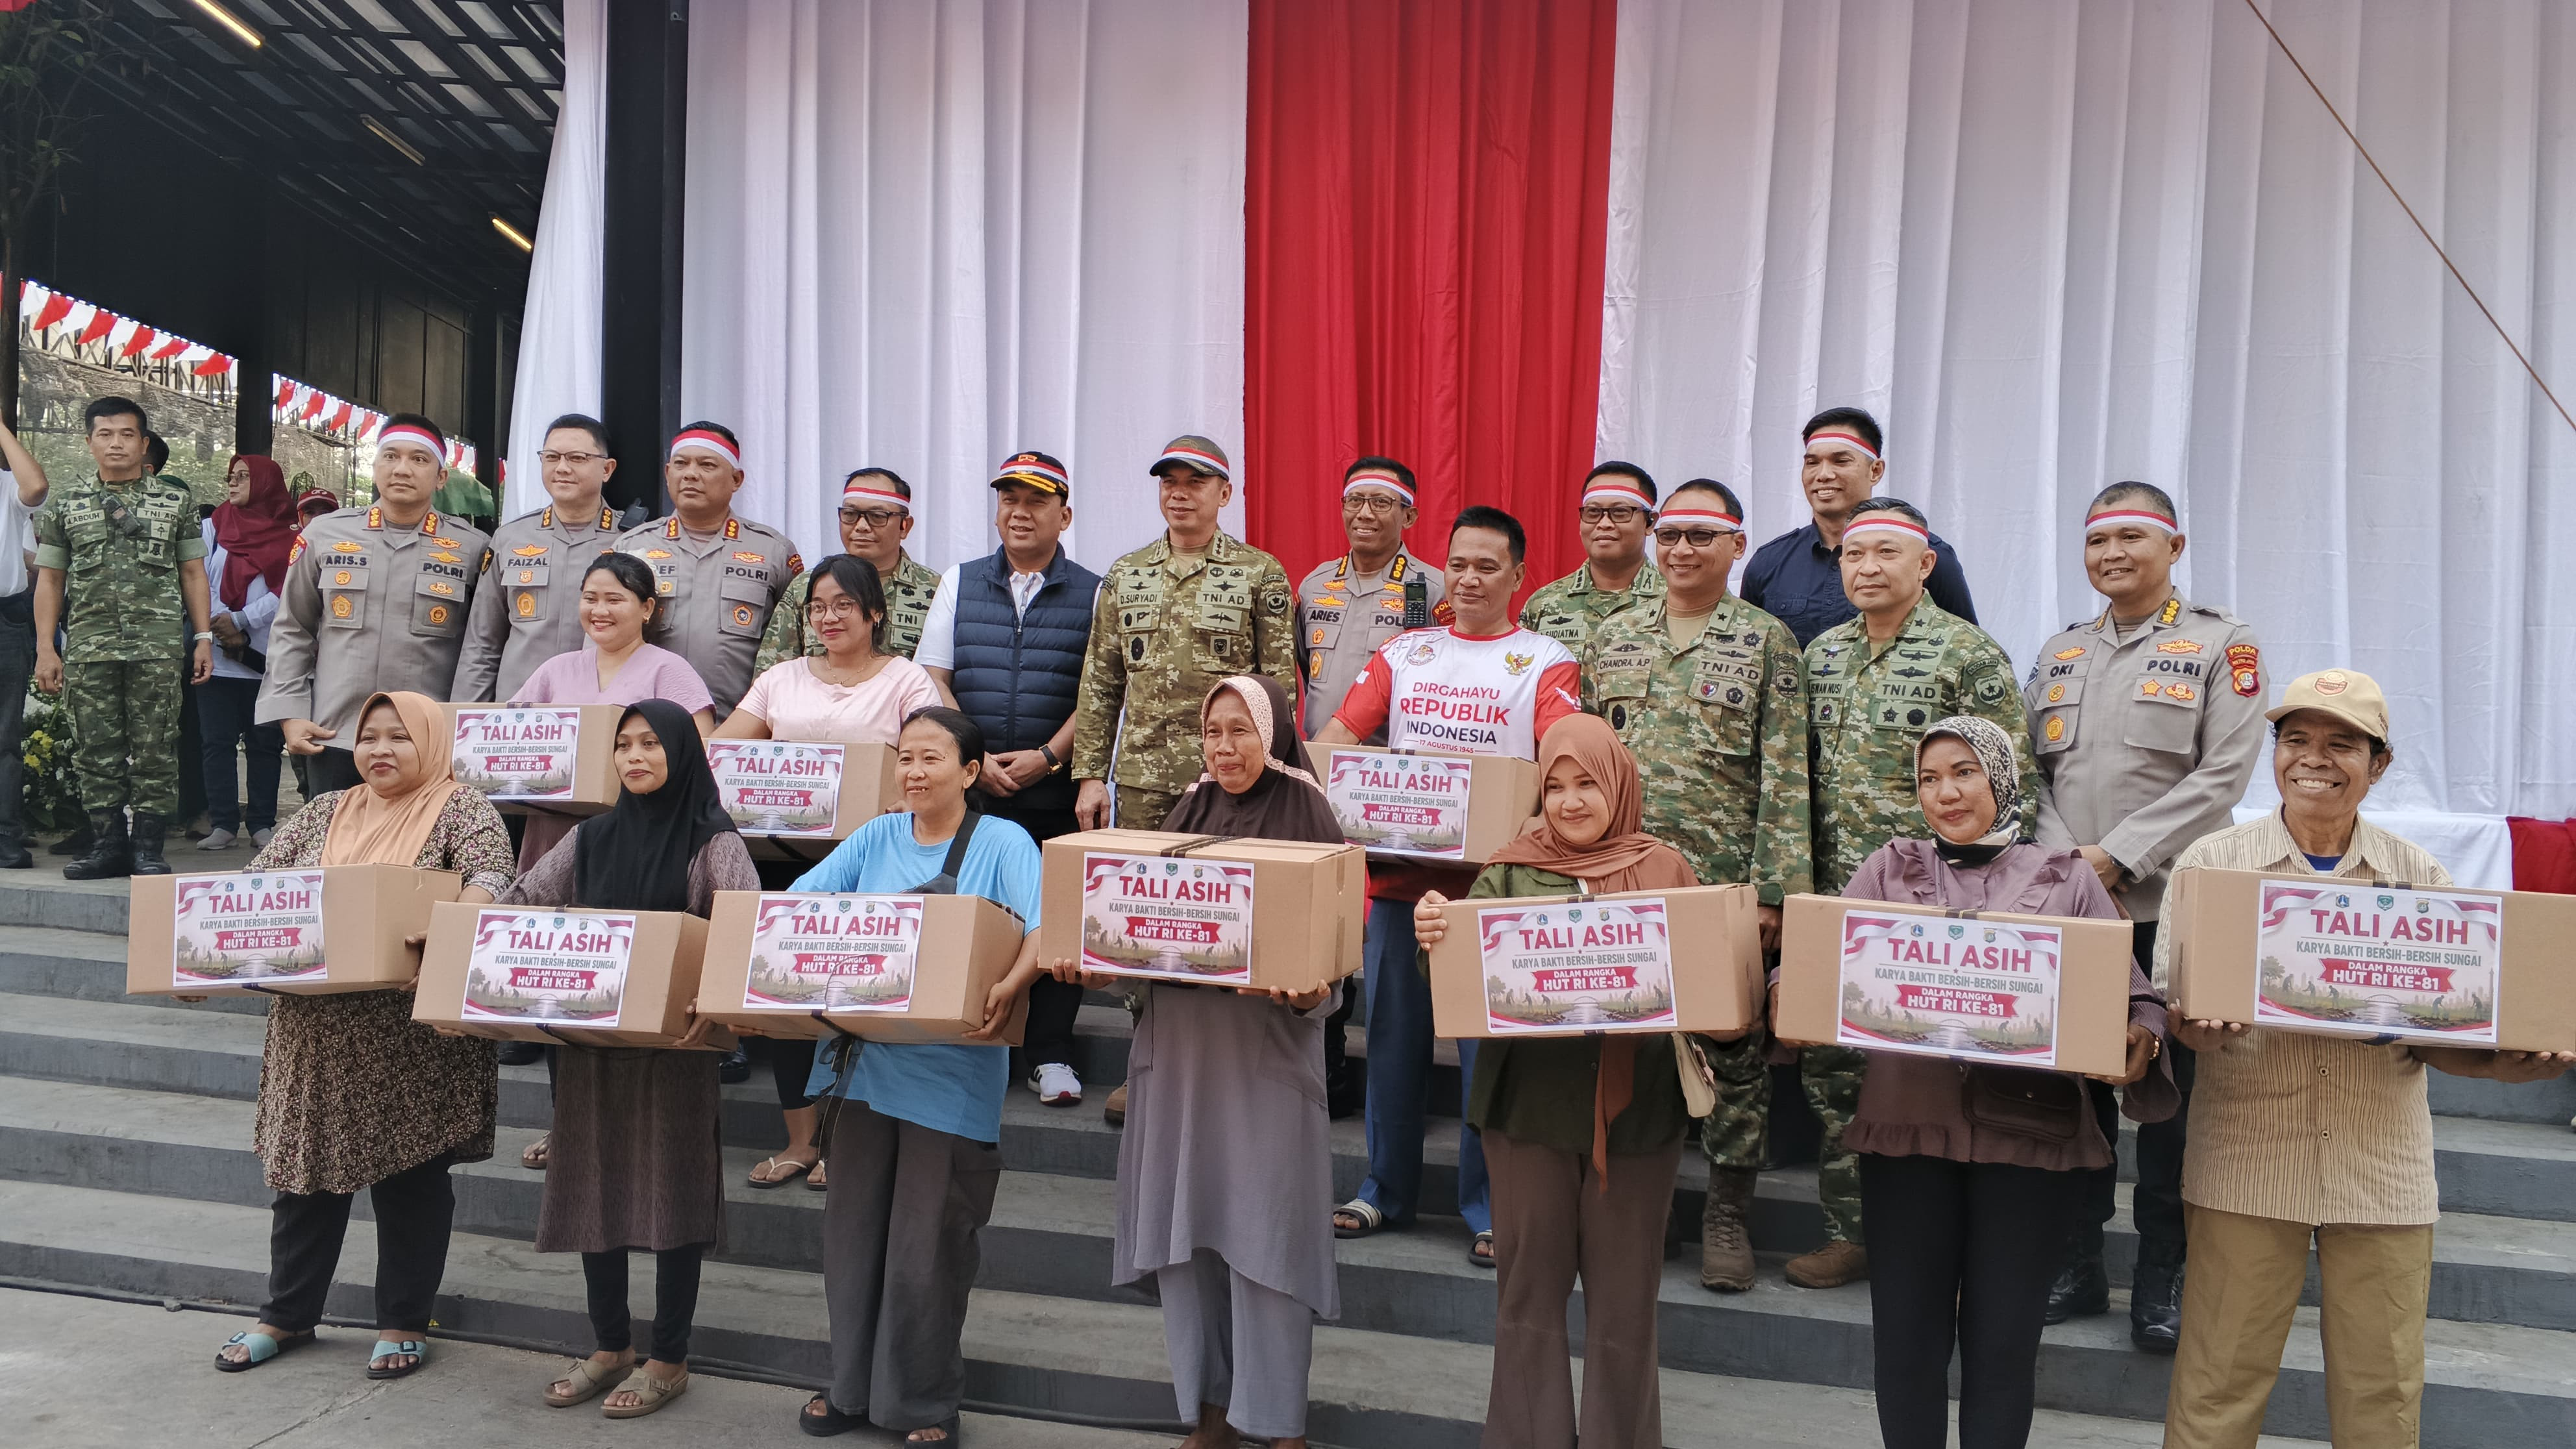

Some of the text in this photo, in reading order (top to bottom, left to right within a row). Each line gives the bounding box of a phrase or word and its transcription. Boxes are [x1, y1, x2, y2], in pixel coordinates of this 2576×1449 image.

[325, 555, 367, 567] ARIS.S
[507, 557, 549, 567] FAIZAL
[423, 563, 464, 578] POLRI
[655, 565, 676, 575] EF
[725, 567, 769, 581] POLRI
[1120, 593, 1158, 604] D.SURYADI
[1204, 593, 1245, 605] TNI AD
[897, 613, 917, 625] TNI
[1309, 610, 1341, 623] ARIES
[1375, 615, 1405, 626] POL
[2229, 645, 2256, 656] POLDA
[1701, 661, 1759, 680] TNI AD
[2050, 663, 2074, 677] OKI
[2146, 660, 2201, 676] POLRI
[1413, 682, 1500, 699] DIRGAHAYU
[1883, 685, 1936, 698] TNI AD
[1400, 697, 1511, 726] REPUBLIK
[482, 724, 562, 740] TALI ASIH
[1407, 721, 1496, 744] INDONESIA
[1428, 741, 1457, 750] AGUSTUS
[736, 758, 825, 776] TALI ASIH
[1359, 770, 1452, 792] TALI ASIH
[744, 795, 804, 805] HUT RI KE-81
[1350, 792, 1457, 808] KARYA BAKTI BERSIH-BERSIH SUNGAI
[1370, 811, 1432, 824] HUT RI KE-81
[1119, 876, 1231, 903] TALI ASIH
[209, 891, 310, 913] TALI ASIH
[1109, 902, 1239, 921] KARYA BAKTI BERSIH-BERSIH SUNGAI
[200, 915, 317, 930] KARYA BAKTI BERSIH-BERSIH SUNGAI
[791, 915, 900, 935] TALI ASIH
[2310, 910, 2468, 945] TALI ASIH
[1135, 926, 1209, 941] HUT RI KE-81
[1519, 923, 1644, 950] TALI ASIH
[223, 936, 291, 948] HUT RI KE-81
[508, 931, 612, 953] TALI ASIH
[779, 941, 906, 952] KARYA BAKTI BERSIH-BERSIH SUNGAI
[1512, 952, 1657, 969] KARYA BAKTI BERSIH-BERSIH SUNGAI
[1888, 938, 2031, 972] TALI ASIH
[2297, 941, 2481, 966] KARYA BAKTI BERSIH-BERSIH SUNGAI
[495, 956, 617, 969] KARYA BAKTI BERSIH-BERSIH SUNGAI
[802, 961, 824, 971] HUT
[844, 963, 875, 974] KE-81
[2348, 961, 2428, 976] DALAM RANGKA
[517, 976, 587, 988] HUT RI KE-81
[1543, 976, 1626, 991] HUT RI KE-81
[1875, 967, 2042, 993] KARYA BAKTI BERSIH-BERSIH SUNGAI
[2333, 970, 2438, 990] HUT RI KE-81
[1922, 988, 1994, 1002] DALAM RANGKA
[1908, 995, 2003, 1015] HUT RI KE-81
